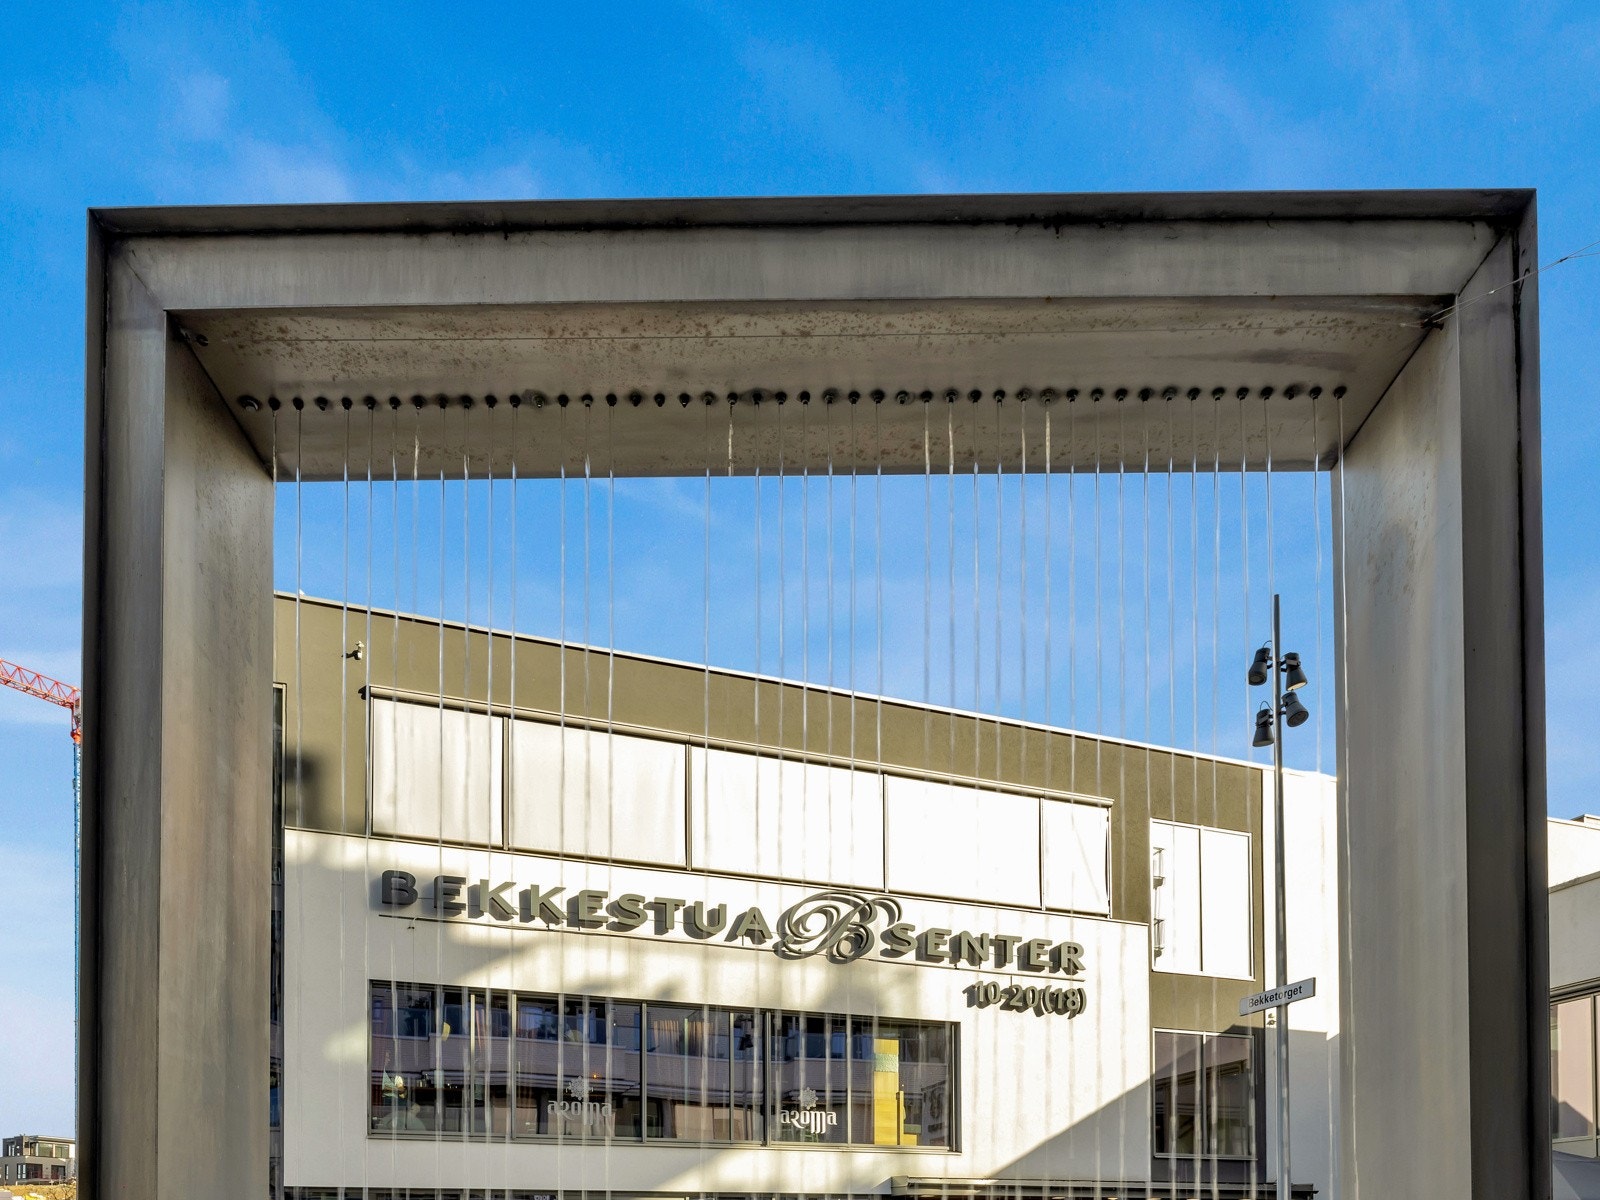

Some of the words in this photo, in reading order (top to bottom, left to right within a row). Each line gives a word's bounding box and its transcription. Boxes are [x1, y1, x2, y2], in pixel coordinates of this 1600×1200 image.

[382, 869, 773, 940] BEKKESTUA
[886, 922, 1086, 973] SENTER
[972, 979, 1087, 1016] 10-20(18)
[1249, 985, 1303, 1008] Bekketorget
[780, 1109, 838, 1134] aroma
